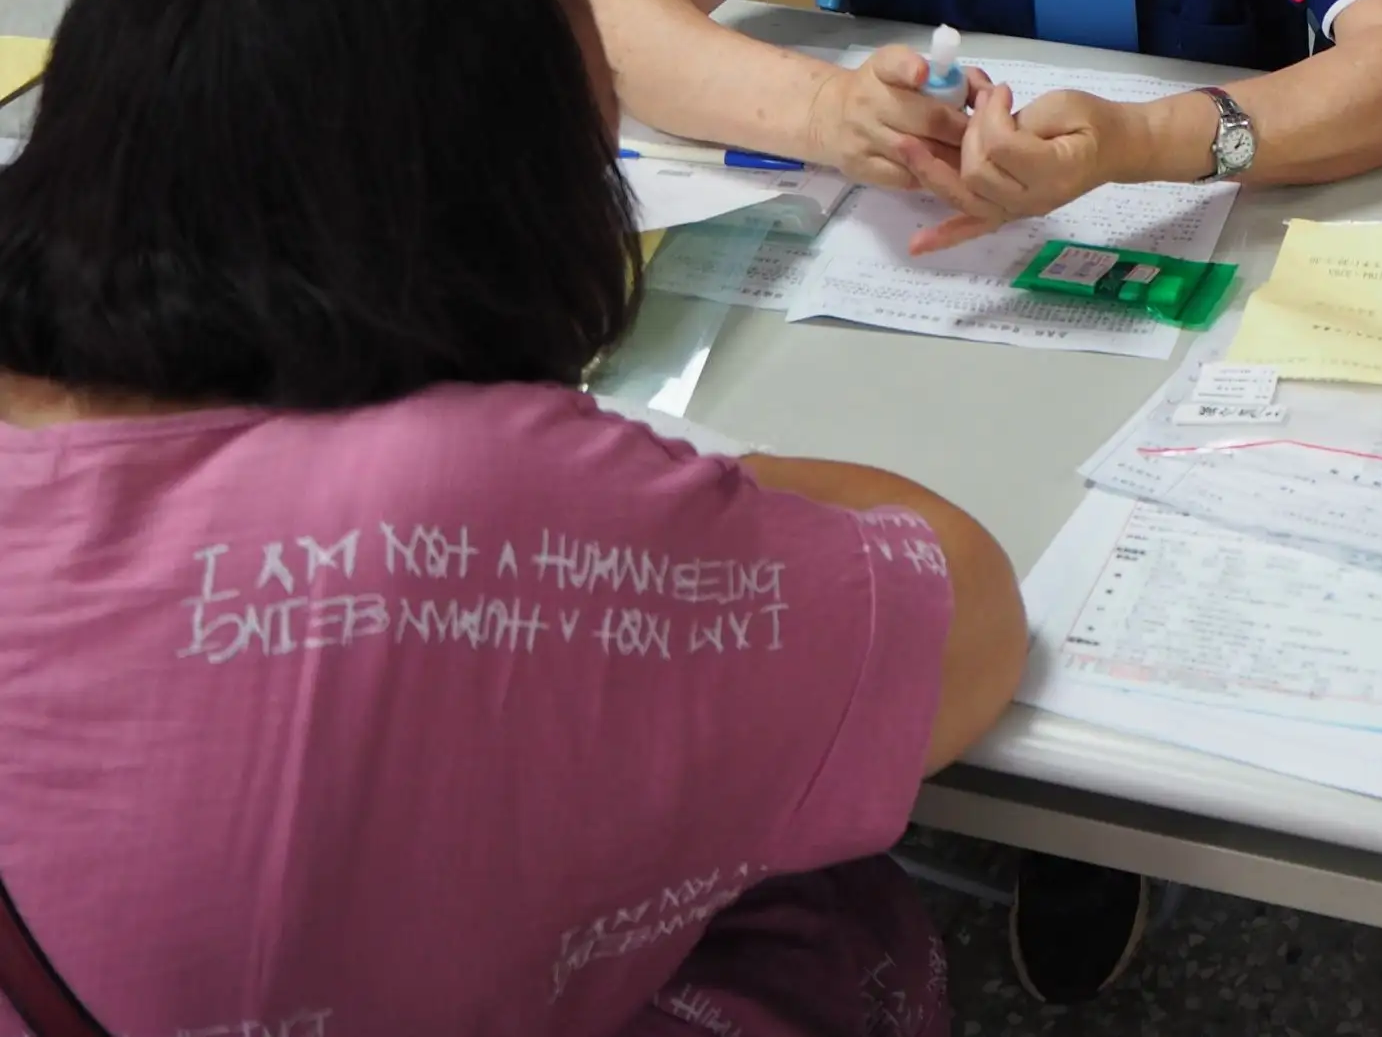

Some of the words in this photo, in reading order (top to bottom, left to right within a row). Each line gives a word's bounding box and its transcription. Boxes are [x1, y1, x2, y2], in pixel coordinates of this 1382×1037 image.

[193, 542, 240, 601] I
[379, 521, 480, 580] NOT
[496, 539, 519, 581] A
[671, 558, 786, 604] BEING
